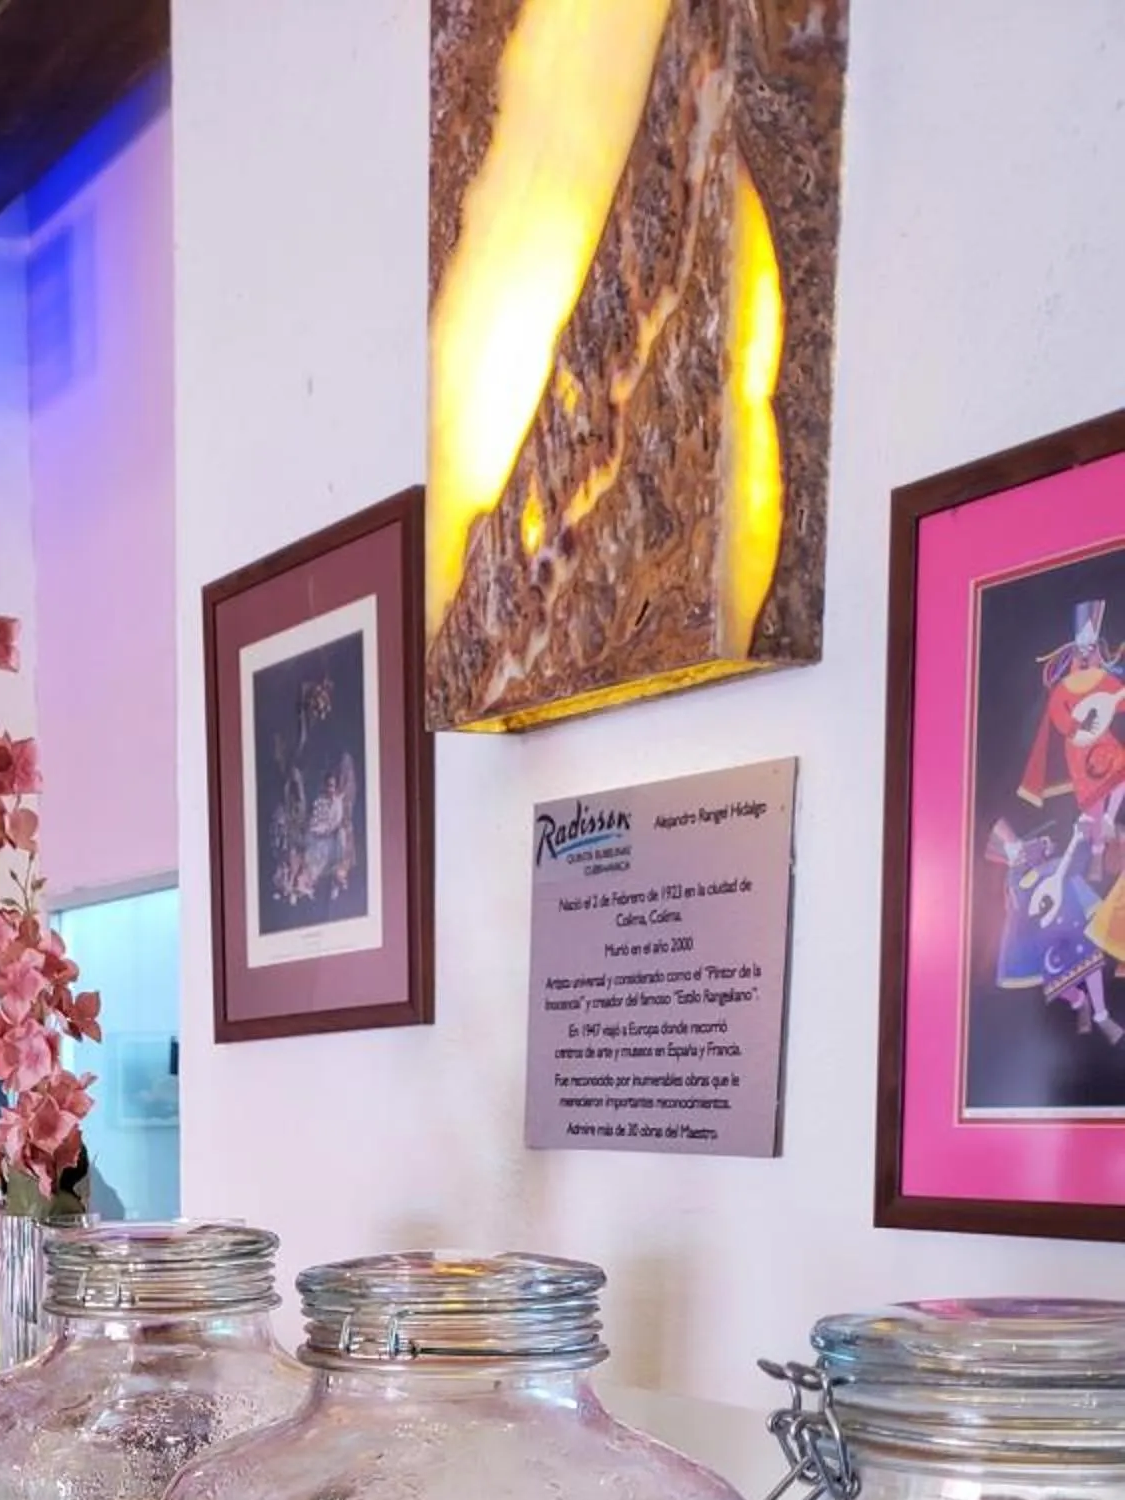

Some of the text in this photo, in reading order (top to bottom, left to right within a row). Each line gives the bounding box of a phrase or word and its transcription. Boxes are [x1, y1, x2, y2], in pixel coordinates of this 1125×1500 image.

[536, 799, 630, 867] Radisson
[707, 877, 737, 896] ciudad
[739, 876, 752, 893] de
[738, 962, 751, 978] de
[628, 1021, 659, 1038] Europa
